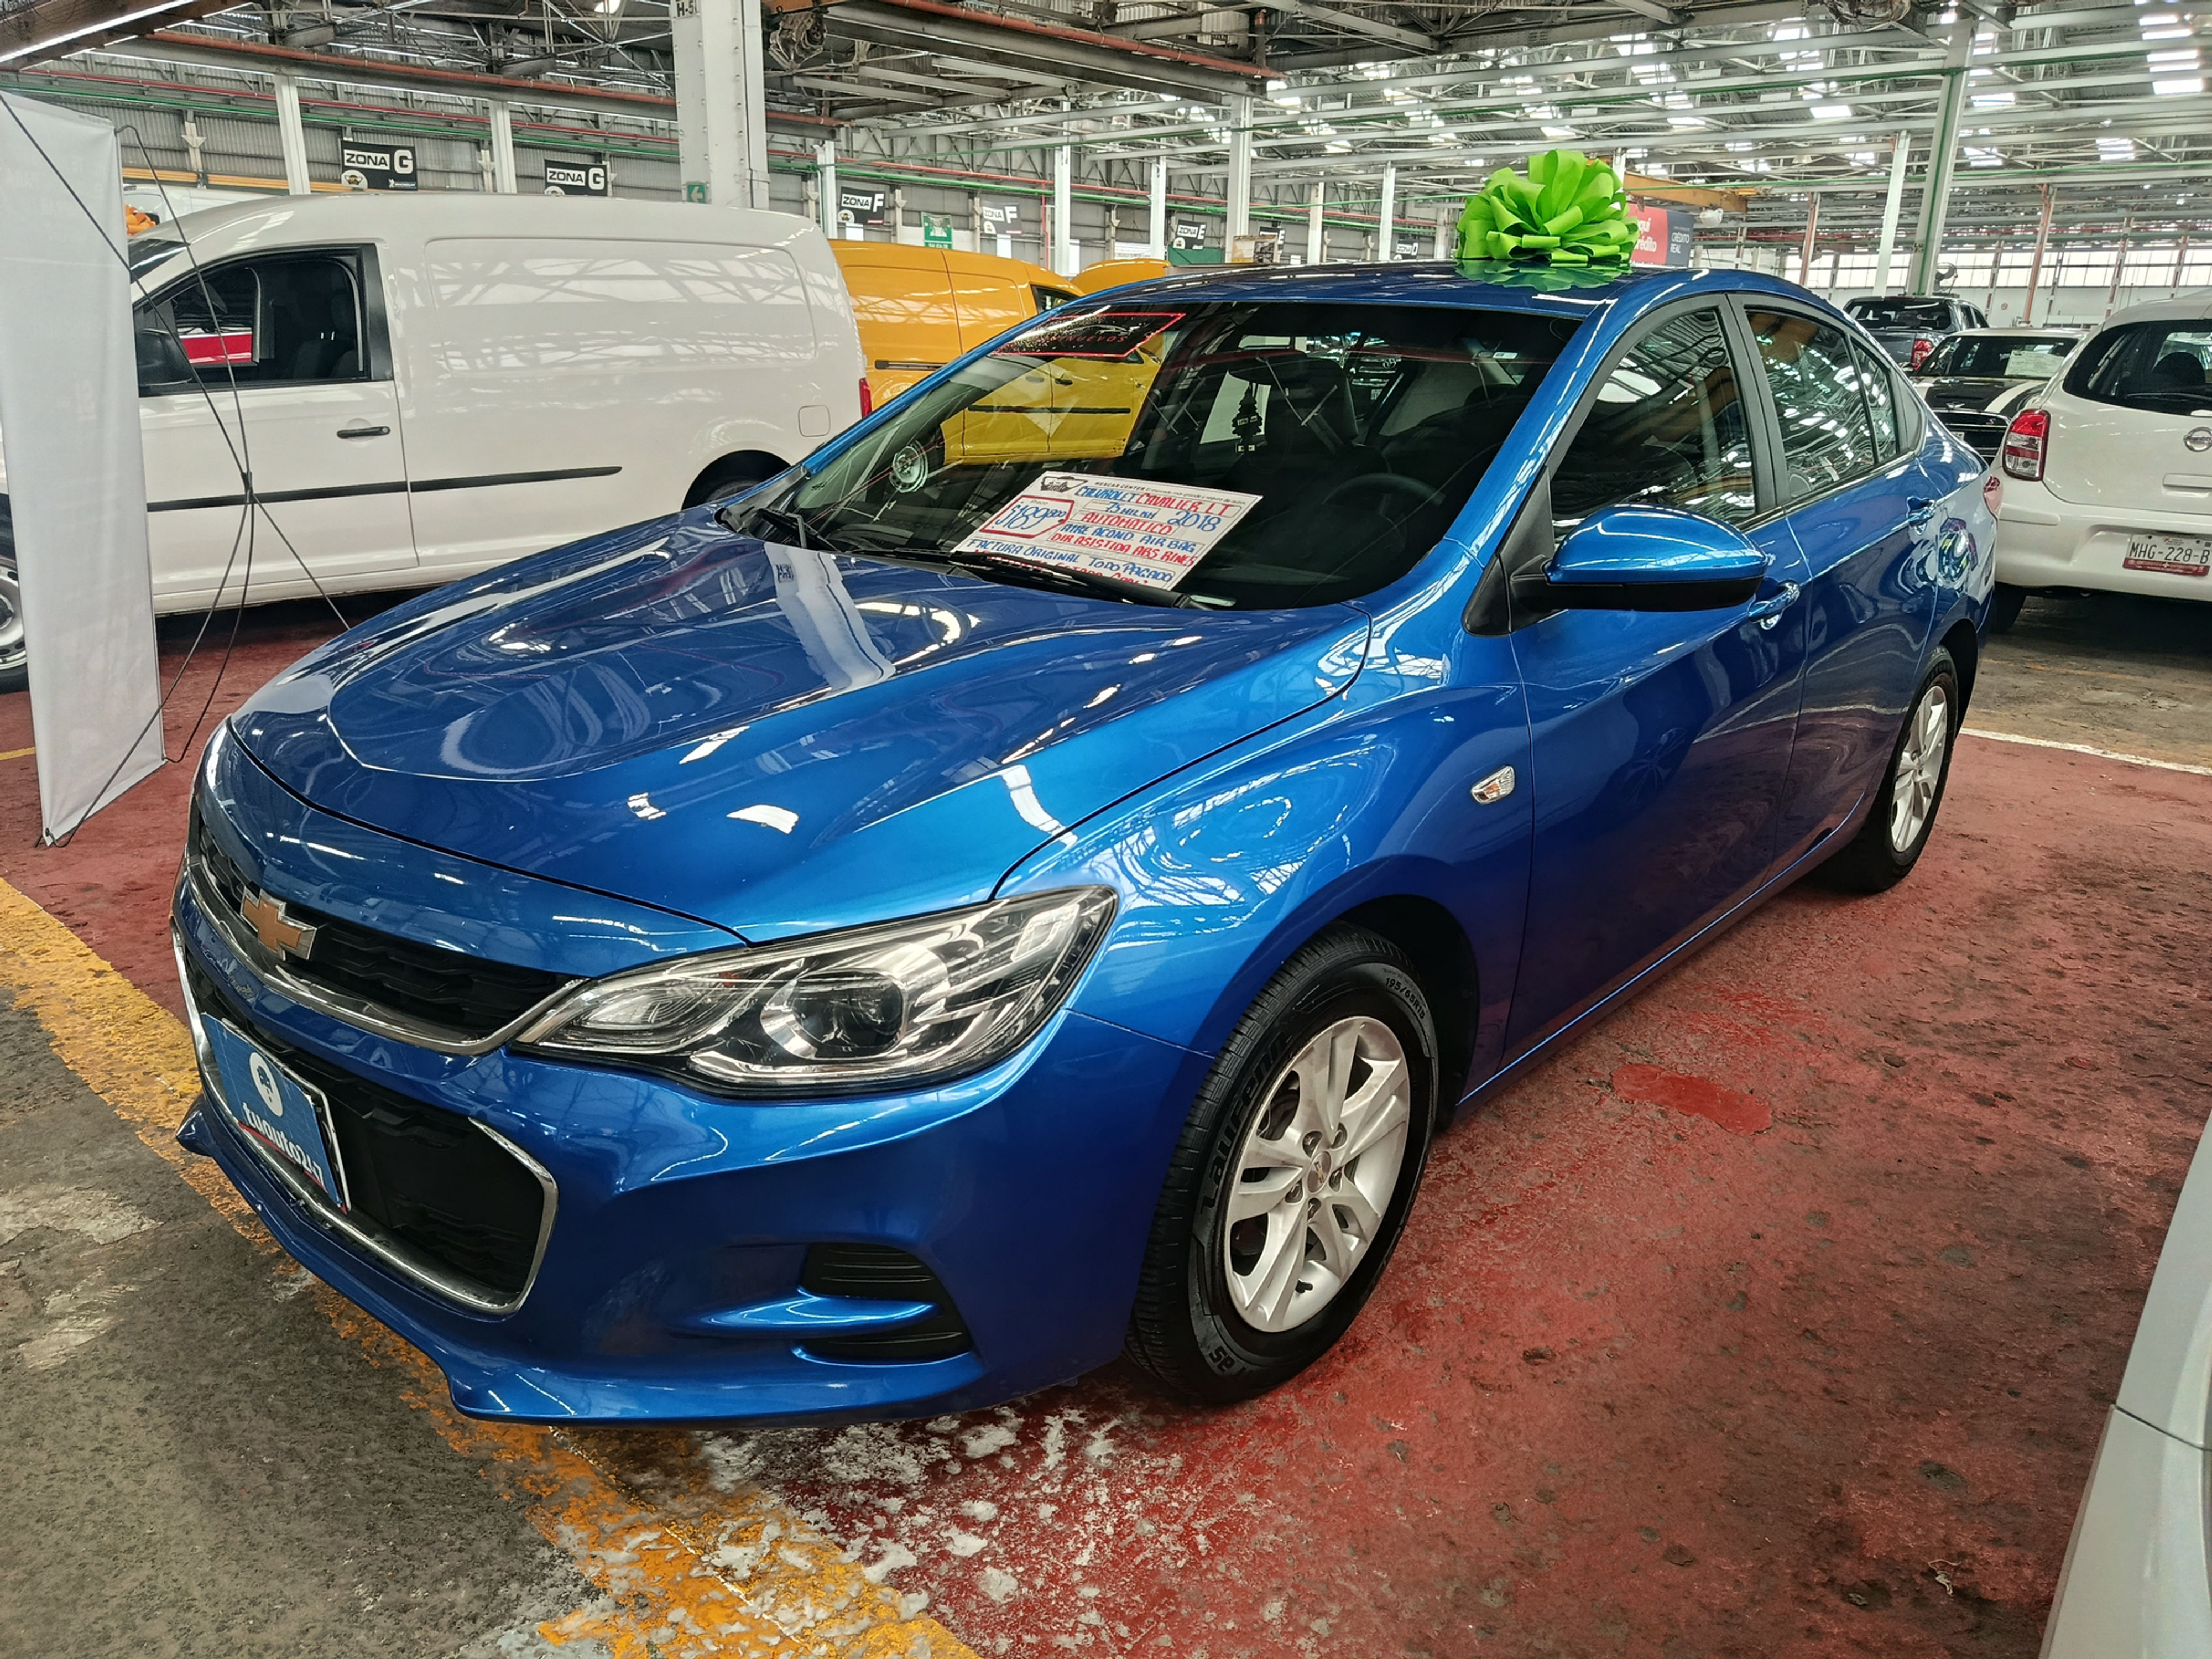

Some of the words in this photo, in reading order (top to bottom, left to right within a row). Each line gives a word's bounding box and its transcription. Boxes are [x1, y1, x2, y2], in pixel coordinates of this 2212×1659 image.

[346, 153, 388, 166] ZONA
[394, 149, 414, 174] G
[549, 171, 583, 183] ZONA
[588, 168, 604, 190] G
[843, 196, 869, 206] ZONA
[873, 194, 884, 212] F
[984, 209, 1003, 218] ZONA
[1004, 206, 1018, 223] F
[1638, 217, 1651, 234] quí
[1178, 227, 1197, 235] ZONA
[1197, 224, 1206, 239] E
[1635, 236, 1657, 252] rédito
[1074, 484, 1139, 502] CHEVROLET
[1135, 492, 1203, 512] CAVALIER
[1105, 501, 1121, 513] 75
[1081, 512, 1173, 535] AUTOMATICO
[1167, 510, 1222, 532] 2018
[1060, 523, 1088, 535] AIRE
[1139, 535, 1165, 547] AIR
[1167, 540, 1196, 554] BAG
[967, 539, 1024, 555] FACTURA
[1024, 546, 1082, 563] ORIGINAL
[1123, 562, 1173, 583] PAGADO
[1051, 533, 1073, 542] DIR
[1074, 535, 1132, 554] ASISTIDA
[1134, 545, 1160, 560] ABS
[1160, 550, 1198, 567] RINES
[2129, 541, 2211, 564] MHG-228-B
[1385, 977, 1426, 1020] 195/65R15
